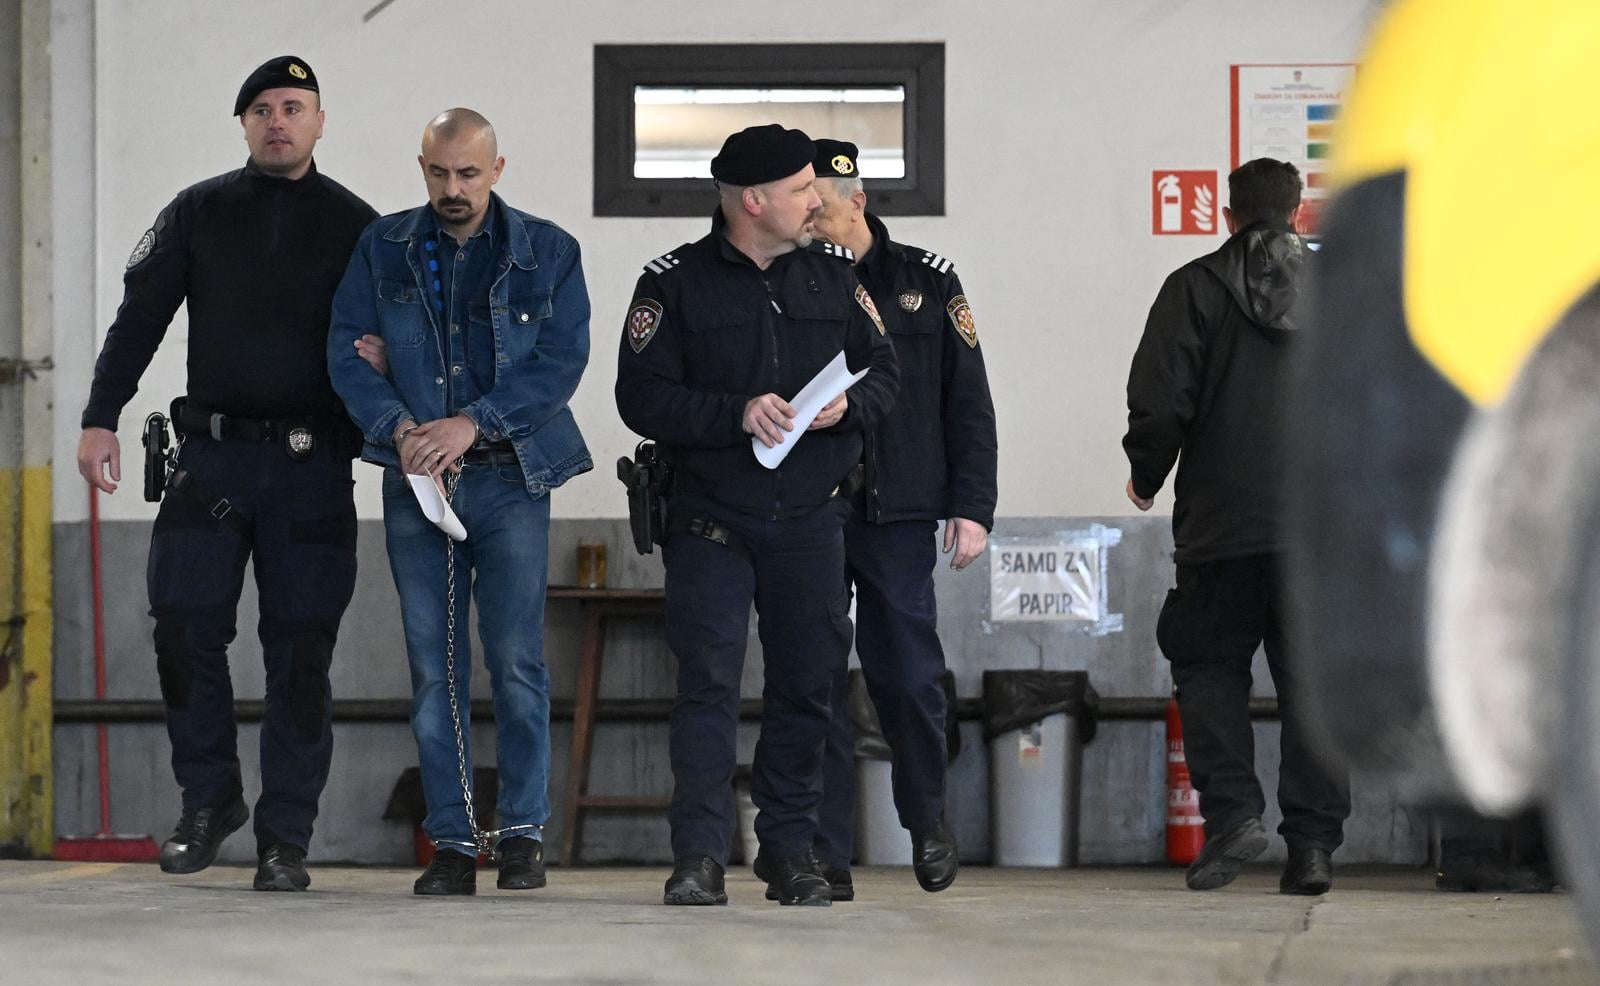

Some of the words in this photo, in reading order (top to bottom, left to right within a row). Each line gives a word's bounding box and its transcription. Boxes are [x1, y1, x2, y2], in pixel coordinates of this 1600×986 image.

[1001, 551, 1056, 573] SAMO
[1064, 551, 1091, 573] ZA
[1019, 592, 1073, 615] PAPIR
